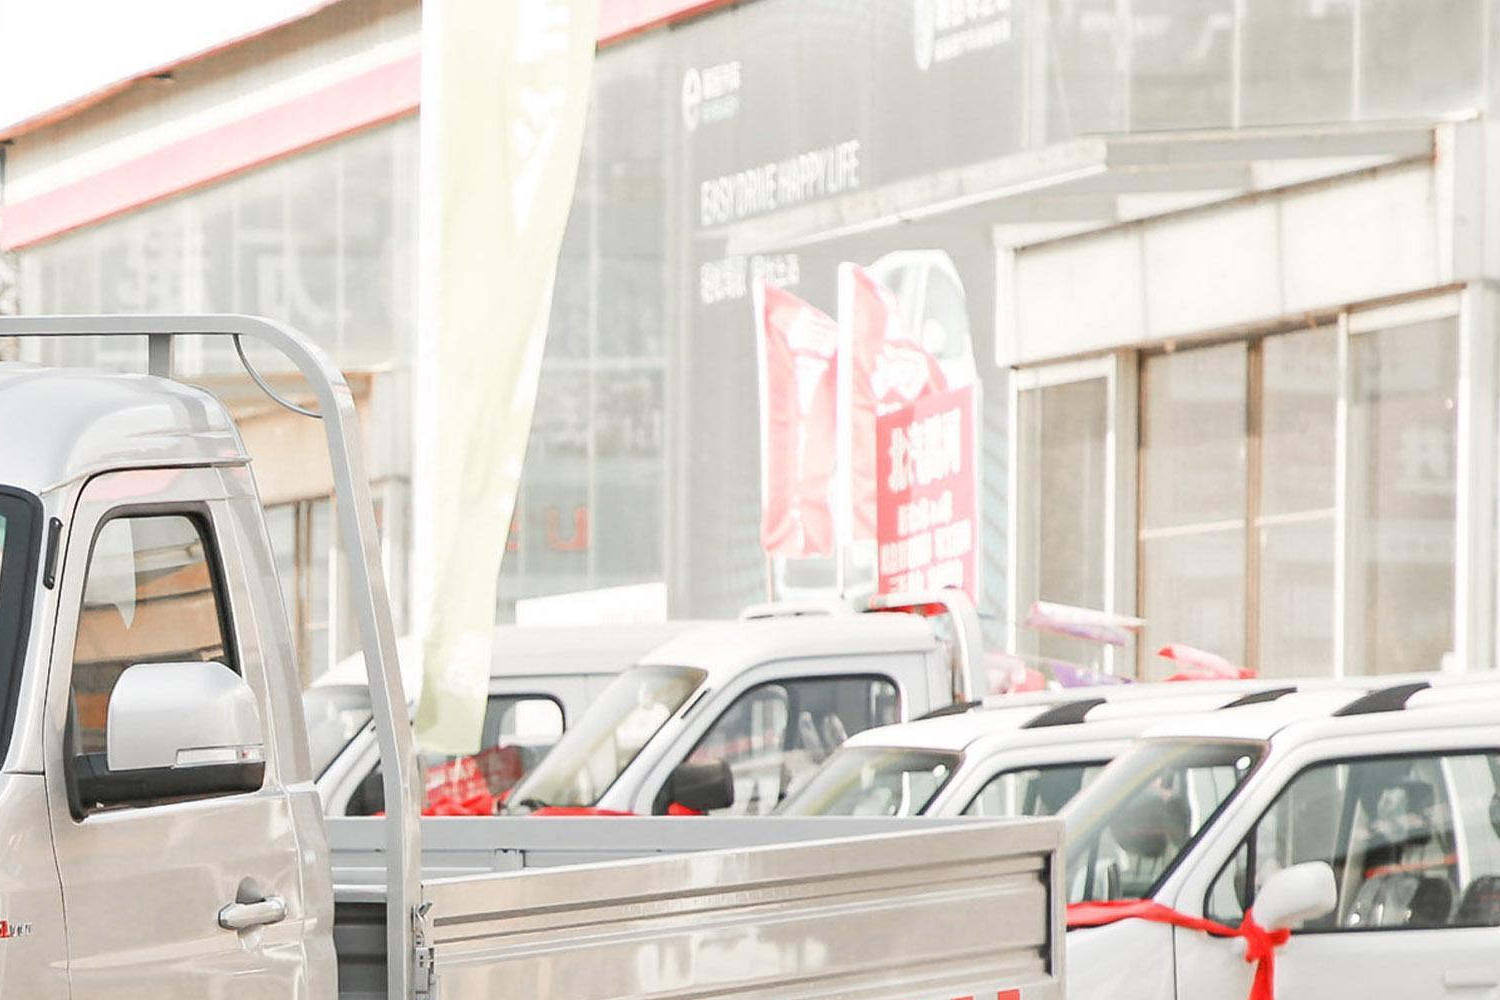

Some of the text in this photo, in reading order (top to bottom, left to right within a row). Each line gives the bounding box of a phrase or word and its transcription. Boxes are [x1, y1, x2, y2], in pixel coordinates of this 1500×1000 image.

[735, 163, 777, 217] DRIVE
[777, 148, 827, 203] HAPPY
[827, 140, 859, 193] LIFE
